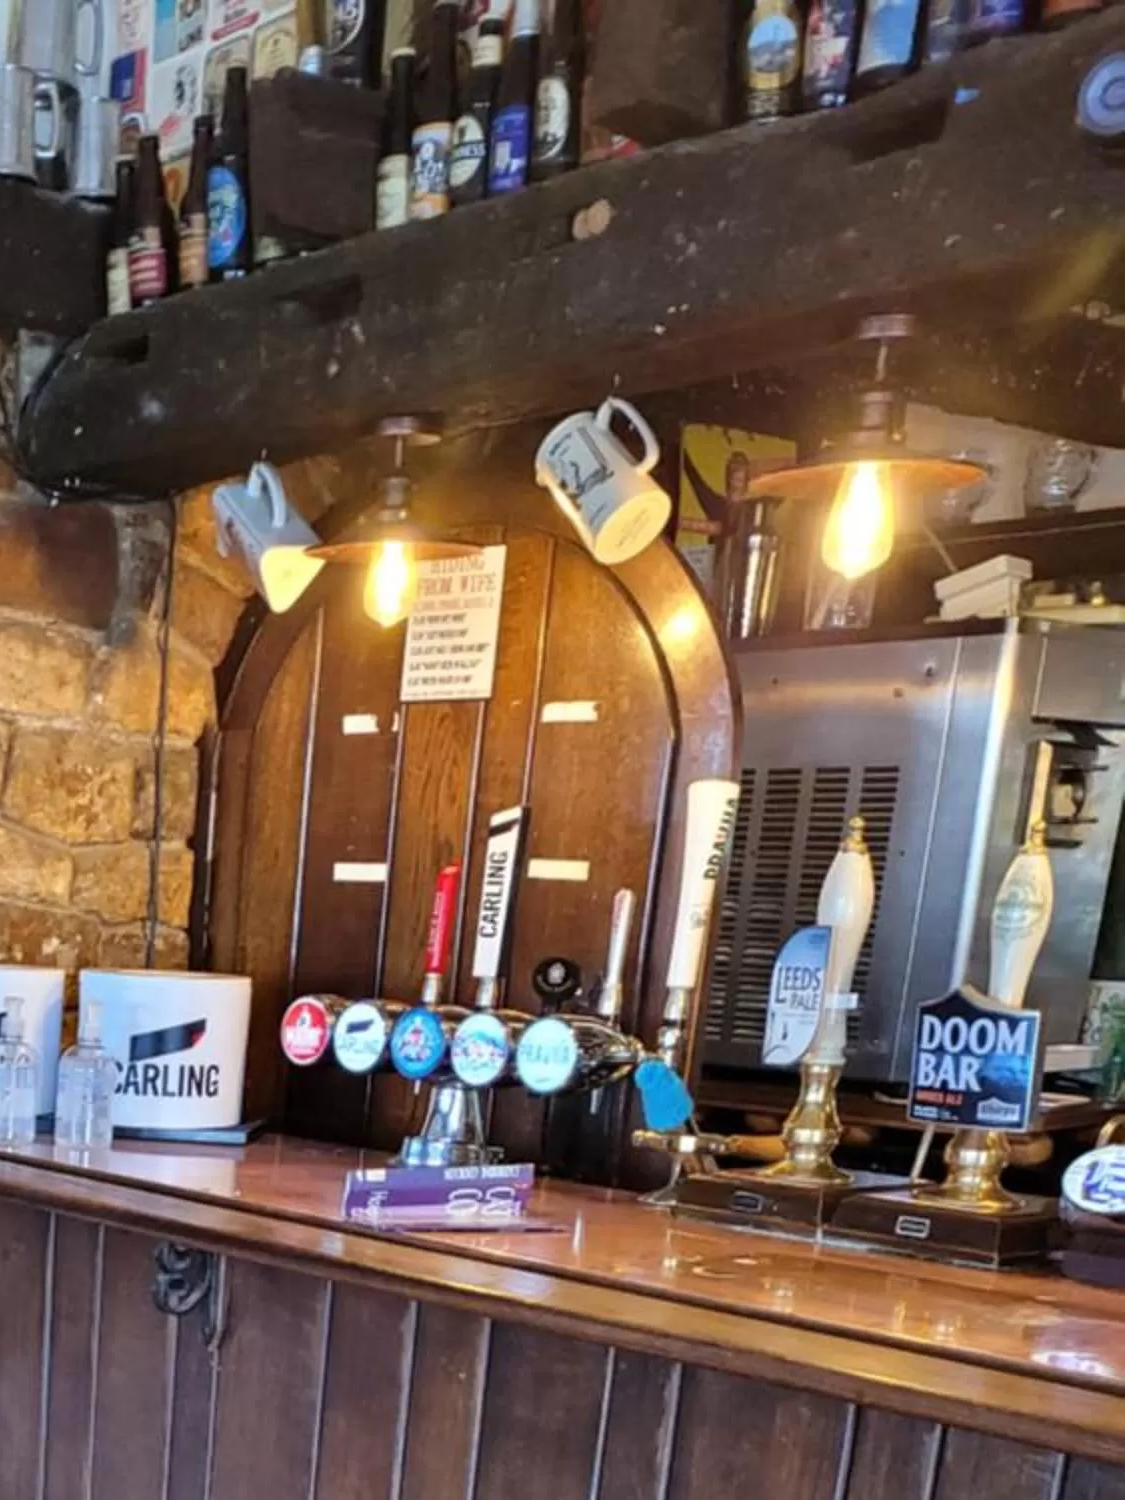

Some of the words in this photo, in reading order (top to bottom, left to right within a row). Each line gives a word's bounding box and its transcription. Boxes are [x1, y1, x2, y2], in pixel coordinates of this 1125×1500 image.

[479, 851, 509, 939] CARLING
[776, 966, 821, 1003] LEEDS
[790, 992, 819, 1011] PALE
[920, 1014, 1029, 1056] DOOM
[916, 1052, 982, 1092] BAR
